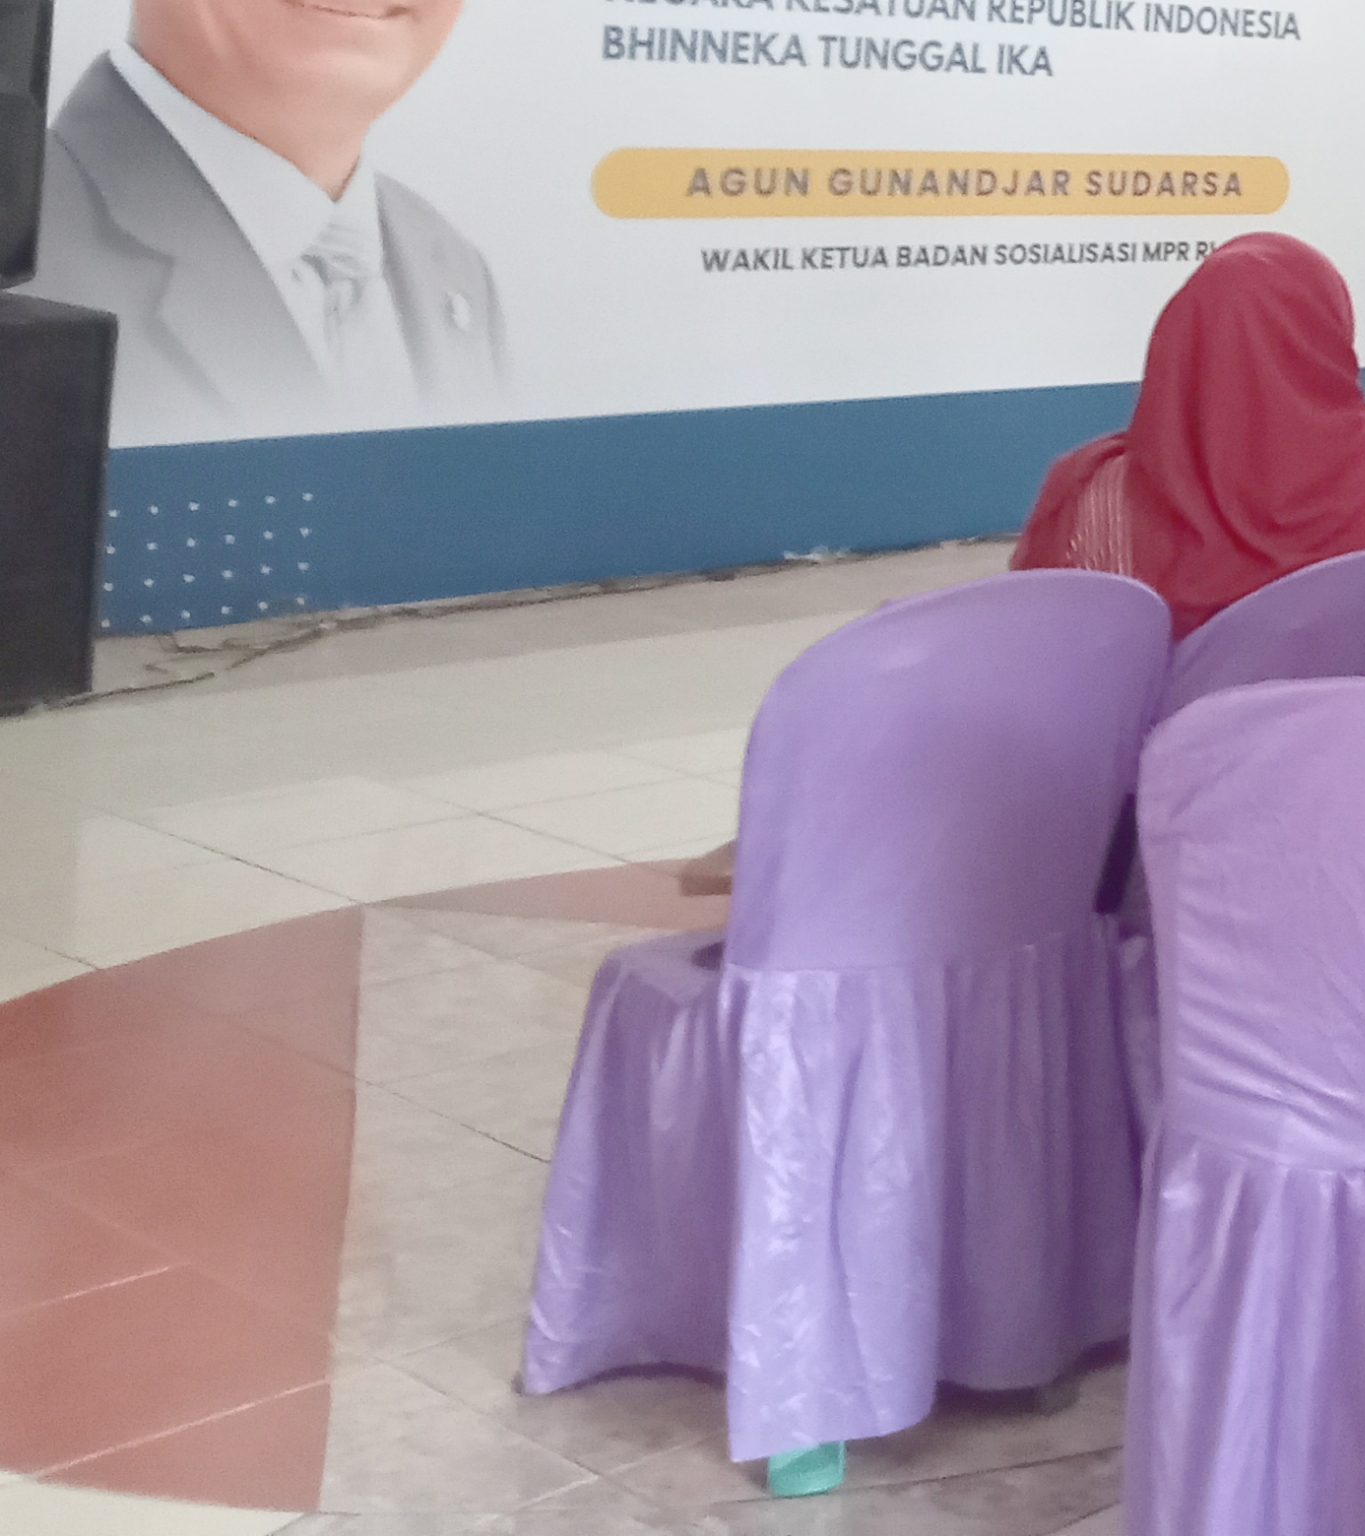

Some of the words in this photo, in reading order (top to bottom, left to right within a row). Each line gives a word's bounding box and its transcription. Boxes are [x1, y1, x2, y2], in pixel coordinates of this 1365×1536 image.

[1143, 1, 1302, 42] INDONESIA
[601, 23, 808, 67] BHINNEKA
[817, 33, 988, 75] TUNGGAL
[997, 41, 1054, 78] IKA
[687, 165, 811, 199] AGUN
[828, 166, 1072, 199] GUNANDJAR
[1084, 169, 1244, 199] SUDARSA
[700, 247, 795, 274] WAKIL
[800, 244, 889, 271] KETUA
[895, 243, 989, 268] BADAN
[993, 239, 1138, 267] SOSIALISASI
[1141, 240, 1191, 264] MPR
